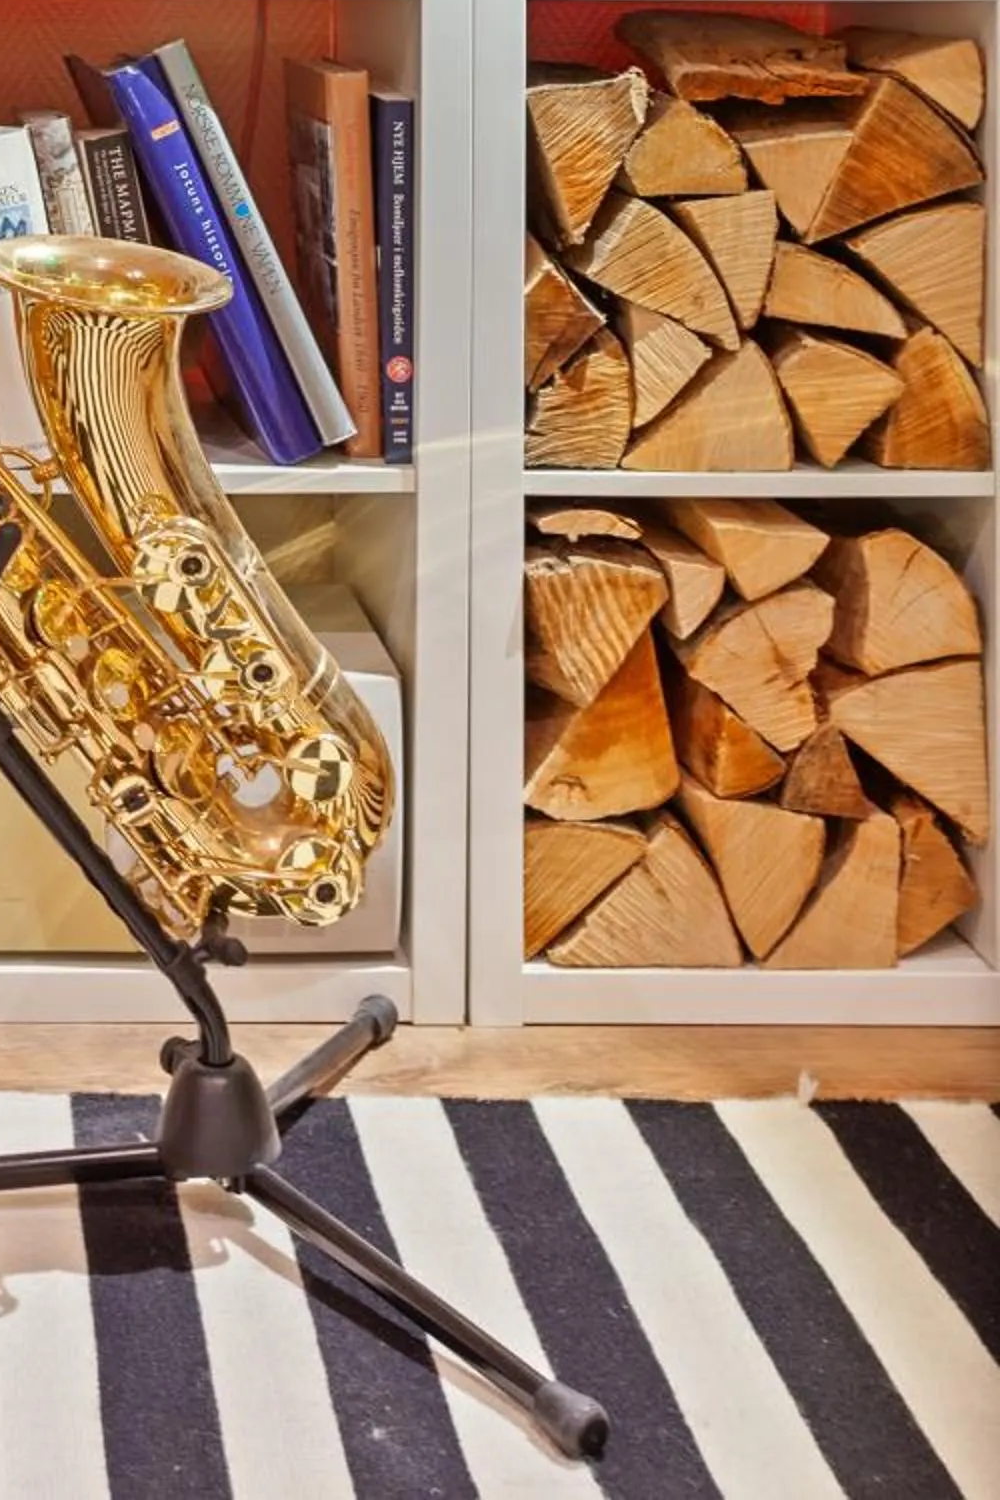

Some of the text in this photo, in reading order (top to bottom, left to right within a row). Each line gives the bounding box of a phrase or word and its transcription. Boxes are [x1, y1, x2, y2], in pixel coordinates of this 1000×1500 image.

[108, 146, 124, 180] THE
[391, 121, 405, 185] NYE HJEM
[174, 163, 203, 214] jotuns
